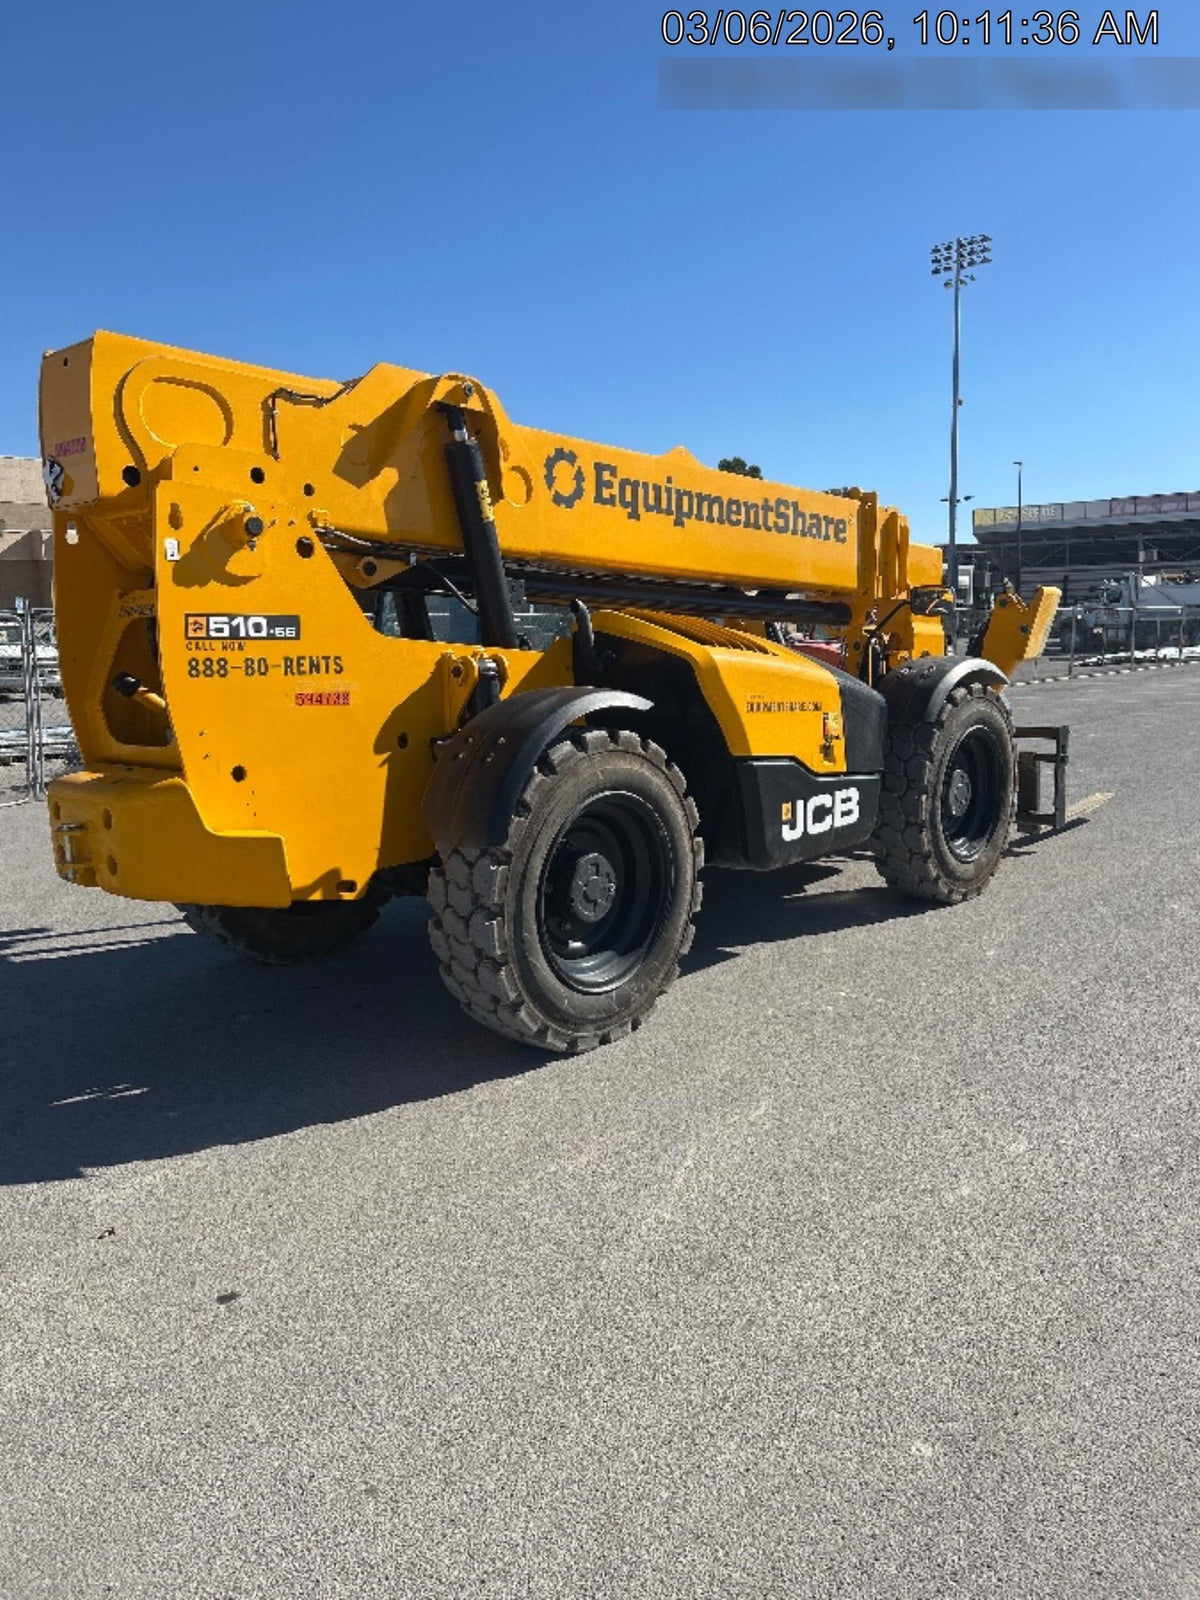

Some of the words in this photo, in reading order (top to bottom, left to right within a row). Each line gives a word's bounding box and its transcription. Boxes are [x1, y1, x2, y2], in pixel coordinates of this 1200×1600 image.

[594, 461, 848, 544] EquipmentShare
[186, 641, 216, 652] CALL
[221, 641, 246, 652] NOW
[781, 787, 860, 842] JCB
